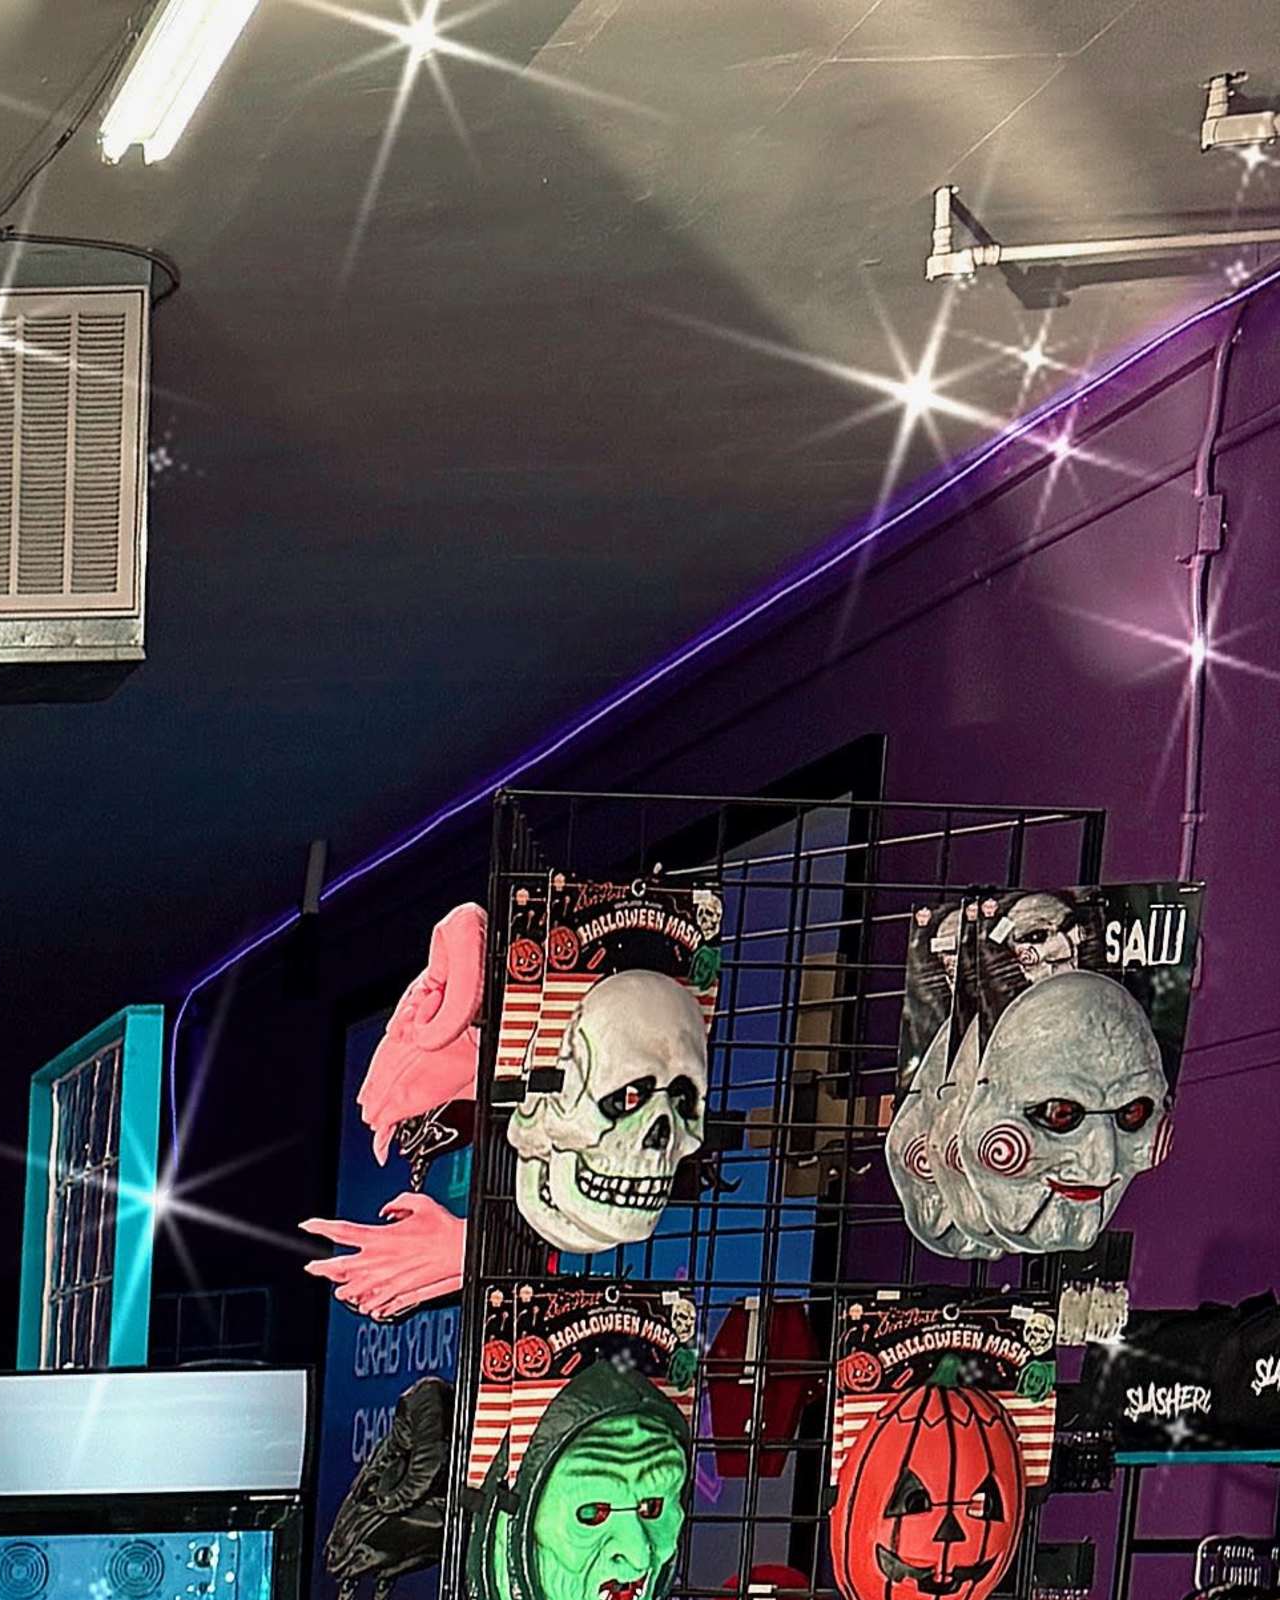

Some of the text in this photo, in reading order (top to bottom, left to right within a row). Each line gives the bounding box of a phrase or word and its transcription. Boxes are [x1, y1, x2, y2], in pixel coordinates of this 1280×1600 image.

[576, 907, 702, 951] HALLOWEEN MASK
[1105, 904, 1187, 967] SAW
[354, 1310, 454, 1377] GRAB YOUR
[548, 1313, 679, 1353] HALLOWEEN MASK
[878, 1329, 1031, 1369] HALLOWEEN MASK
